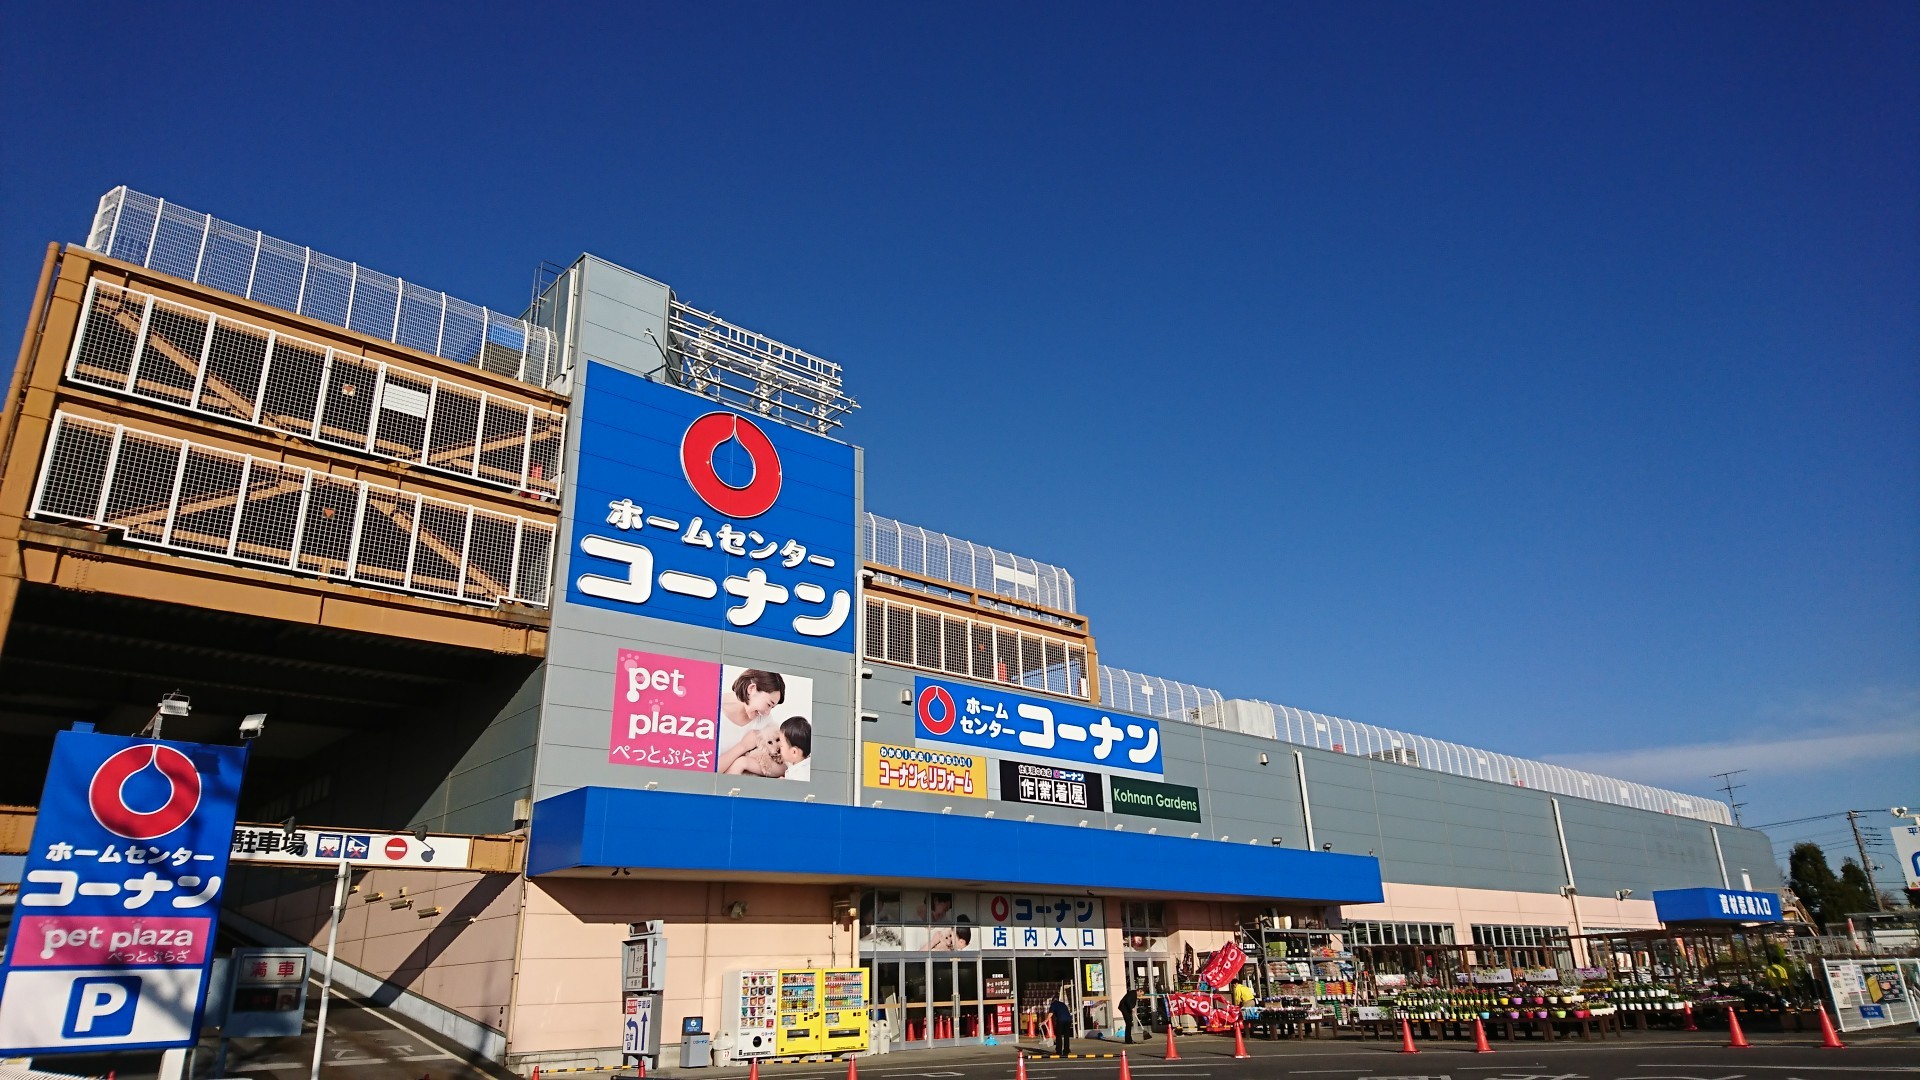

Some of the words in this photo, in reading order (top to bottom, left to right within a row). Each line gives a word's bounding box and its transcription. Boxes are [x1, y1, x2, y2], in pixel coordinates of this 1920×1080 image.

[607, 499, 835, 568] ホームセンター
[577, 534, 851, 636] コーナン
[627, 666, 686, 703] pet
[966, 697, 1008, 720] ホーム
[628, 710, 714, 740] plaza
[960, 716, 1016, 738] センター
[1017, 703, 1159, 764] コーナン
[612, 744, 713, 769] ぺっとぷらざ
[880, 760, 974, 794] コーナンでリフォーム
[1059, 770, 1085, 781] コーナン
[1020, 778, 1085, 805] 作業着屋
[1113, 788, 1153, 806] Kohnan
[1155, 793, 1197, 812] Gardens
[46, 842, 214, 866] ホームセンター
[21, 870, 221, 909] コーナン
[1016, 899, 1093, 922] コーナン
[40, 926, 103, 960] pet
[109, 927, 193, 952] plaza
[993, 925, 1094, 947] 店内入口
[108, 950, 191, 962] ぺっとぷらざ
[251, 961, 296, 977] 満車
[74, 983, 127, 1032] P
